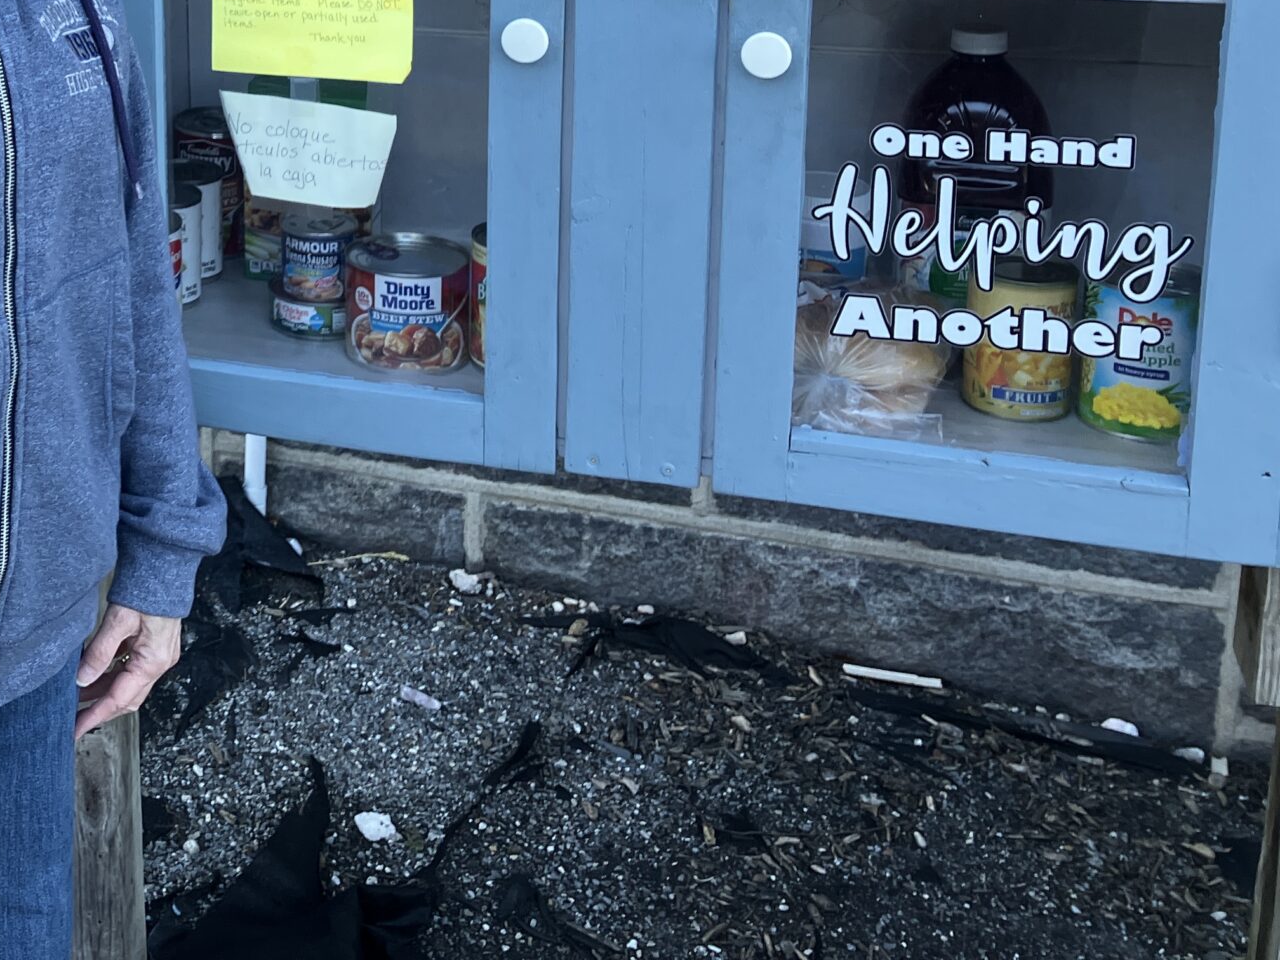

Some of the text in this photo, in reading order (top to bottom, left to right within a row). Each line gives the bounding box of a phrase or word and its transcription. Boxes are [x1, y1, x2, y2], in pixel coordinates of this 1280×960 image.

[223, 6, 379, 27] leave open or partially used
[65, 29, 101, 61] 196
[308, 32, 366, 47] Thank you
[226, 112, 336, 149] No coloque
[236, 141, 299, 158] rticulos
[873, 125, 1135, 168] One Hand
[259, 162, 318, 189] la caja
[813, 163, 1193, 303] Helping
[285, 237, 339, 254] ARMOUR
[384, 281, 431, 299] Dinty
[380, 294, 435, 311] Moore
[372, 311, 407, 323] BEEF
[409, 314, 445, 325] STEW
[831, 295, 1163, 360] Another
[1004, 391, 1052, 403] FRUIT
